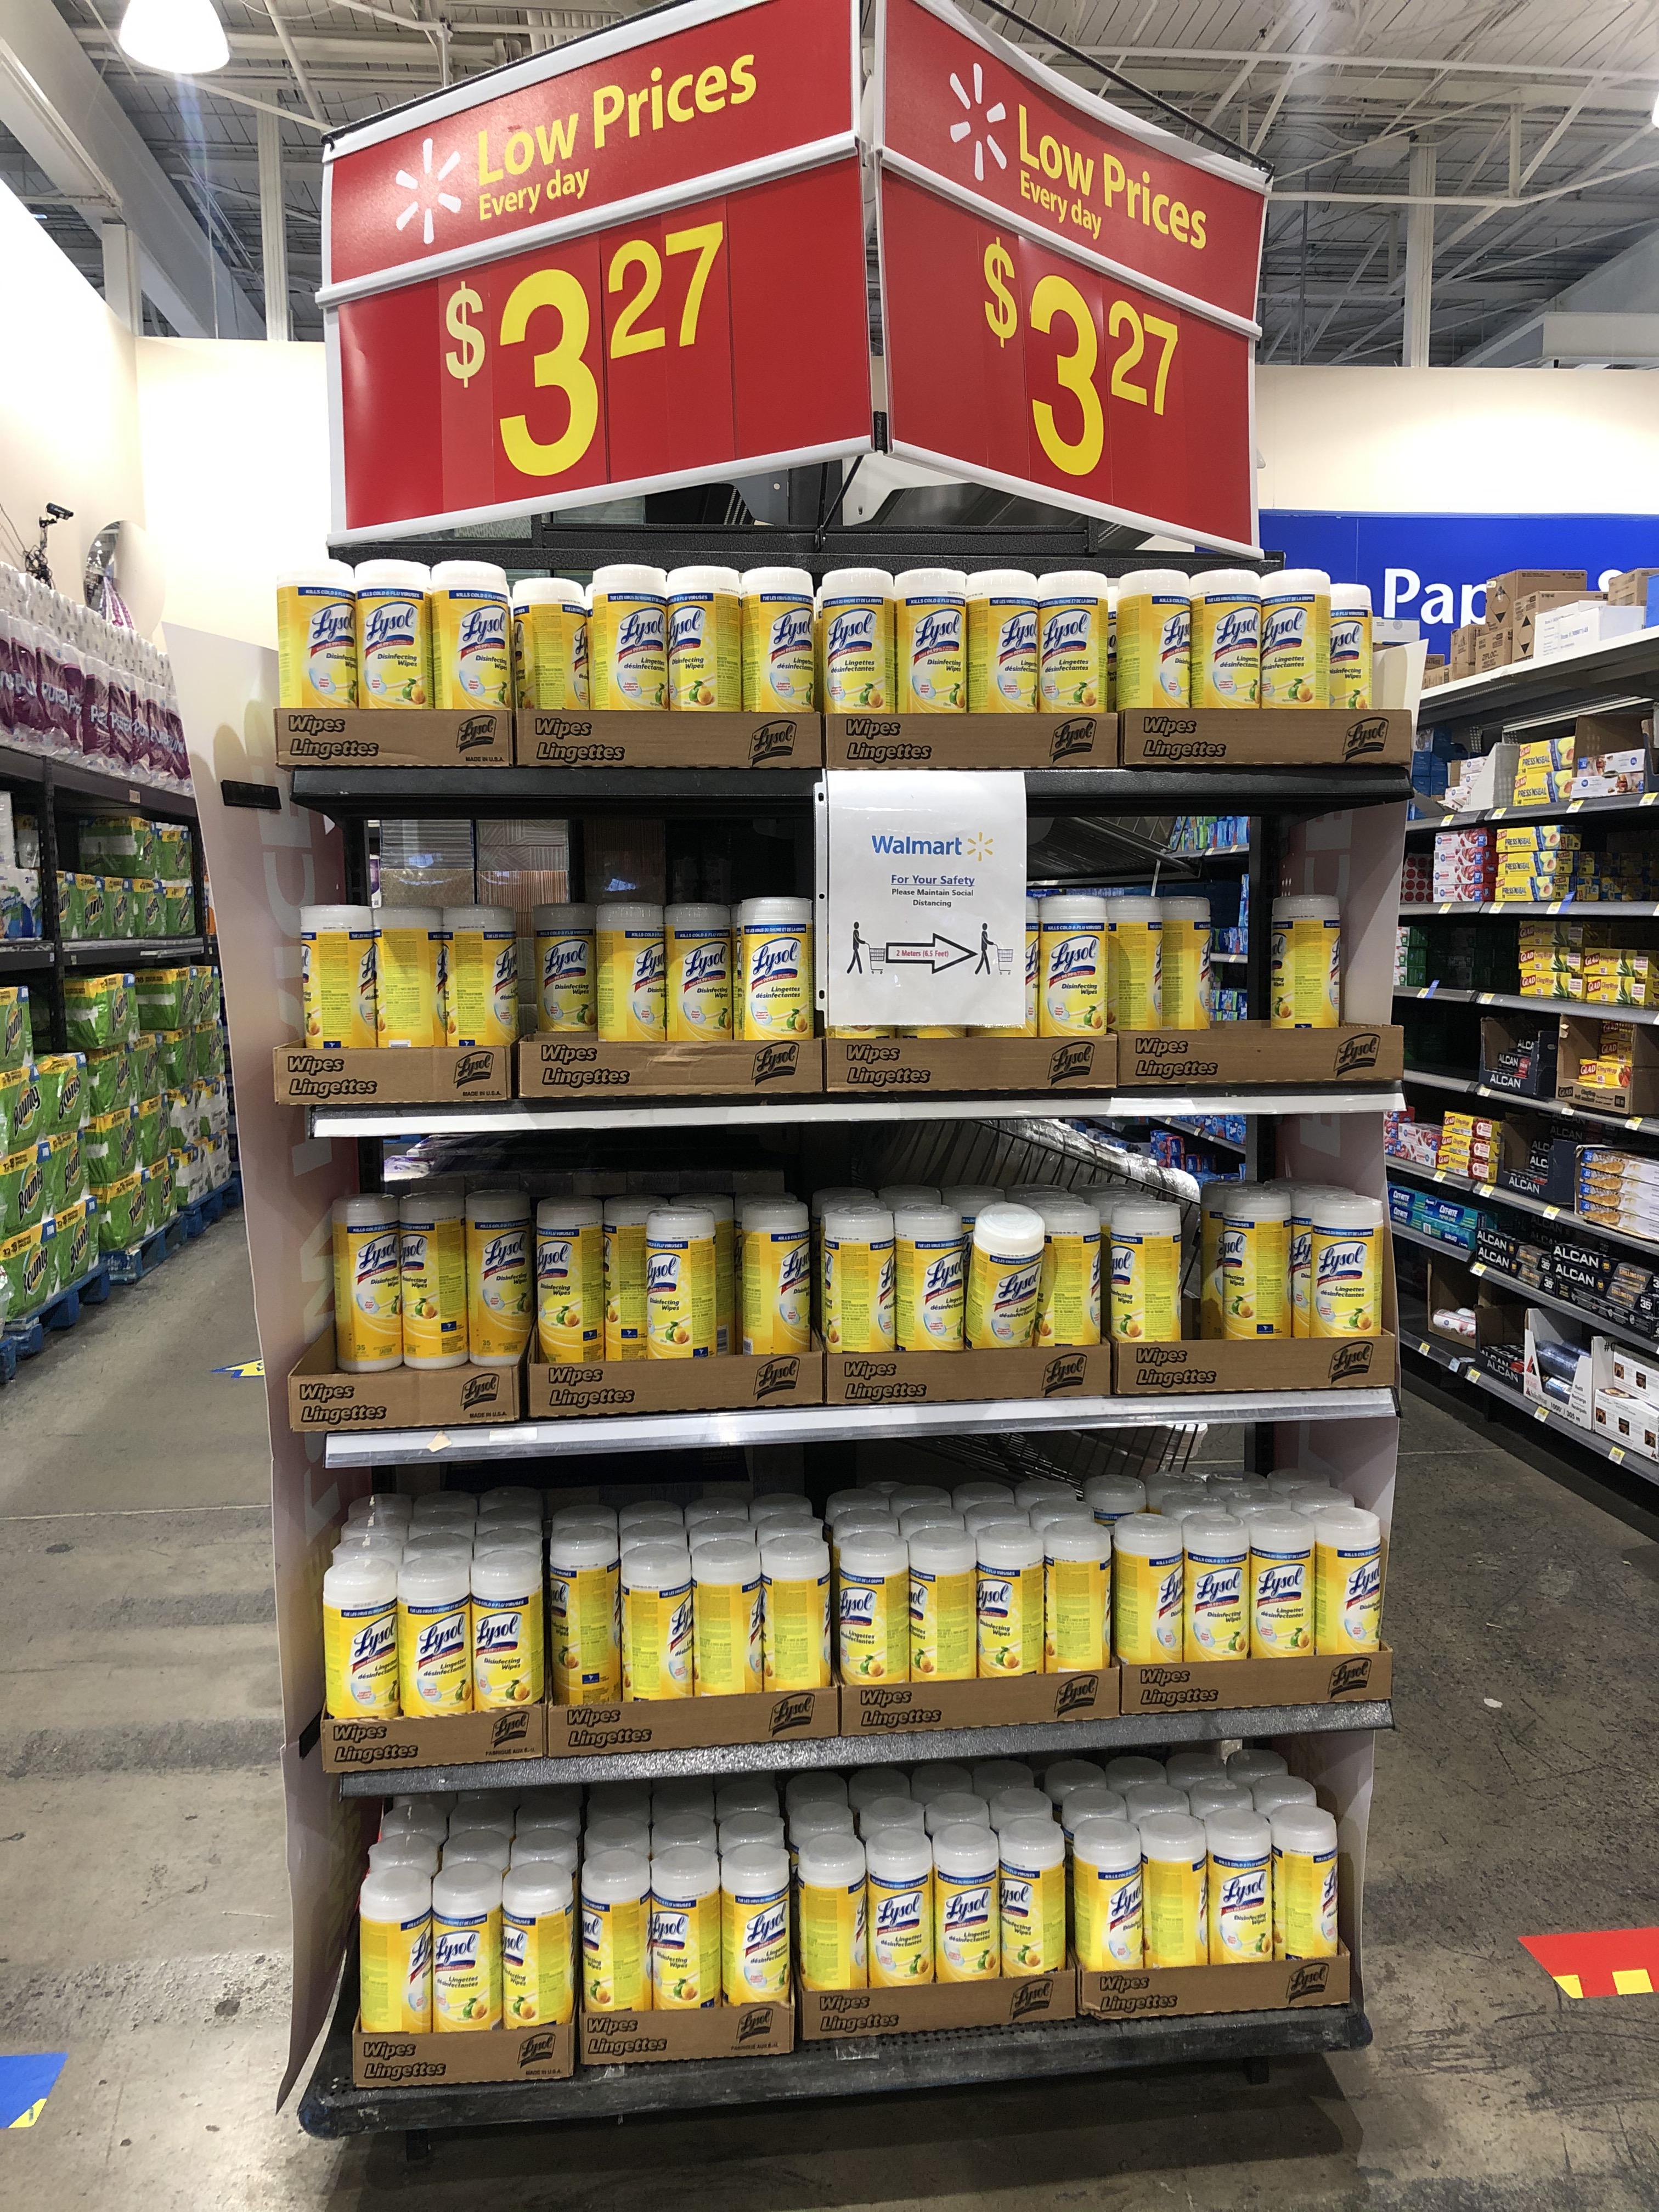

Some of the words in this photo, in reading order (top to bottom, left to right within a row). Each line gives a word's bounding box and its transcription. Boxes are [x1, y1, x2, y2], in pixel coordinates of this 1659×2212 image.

[478, 112, 580, 186] Low
[593, 54, 757, 149] Prices
[1018, 104, 1094, 195] Low
[1103, 152, 1207, 249] Prices
[479, 184, 540, 220] Every
[546, 168, 589, 200] day
[1020, 171, 1068, 224] Every
[1072, 206, 1102, 240] day
[366, 607, 414, 641] Lysol
[620, 611, 664, 645] Lysol
[828, 615, 873, 648] Lysol
[916, 614, 960, 647] Lysol
[1043, 615, 1086, 648] Lysol
[831, 665, 874, 673] désinfectantes
[844, 659, 874, 668] Lingettes
[927, 658, 961, 667] Disinfecting
[289, 715, 345, 735] Wipes
[460, 719, 494, 741] Lysol
[535, 718, 591, 739] Wipes
[847, 719, 901, 740] Wipes
[1054, 722, 1093, 749] Lysol
[1143, 716, 1197, 735] Wipes
[1347, 720, 1385, 748] Lysol
[753, 723, 793, 751] Lysol
[290, 738, 378, 759] Lingettes
[537, 742, 625, 763] Lingettes
[847, 742, 931, 763] Lingettes
[1143, 740, 1226, 760] Lingettes
[872, 835, 962, 855] Walmart
[891, 874, 909, 884] For
[912, 875, 937, 884] Your
[940, 876, 975, 887] Safety
[545, 943, 585, 974] Lysol
[752, 943, 797, 978] Lysol
[1051, 939, 1096, 972] Lysol
[1520, 951, 1534, 962] GLAD
[1585, 955, 1599, 966] GLAD
[1522, 977, 1536, 986] GLAD
[1588, 981, 1601, 992] GLAD
[541, 1045, 597, 1063] Wipes
[847, 1045, 900, 1063] Wipes
[1136, 1038, 1188, 1057] Wipes
[1339, 1037, 1376, 1065] Lysol
[287, 1056, 345, 1075] Wipes
[458, 1055, 490, 1077] Lysol
[757, 1045, 795, 1072] Lysol
[1052, 1047, 1091, 1073] Lysol
[1499, 1054, 1519, 1066] ALCAN
[543, 1068, 630, 1088] Lingettes
[847, 1068, 931, 1086] Lingettes
[1136, 1060, 1218, 1079] Lingettes
[1581, 1064, 1596, 1075] GLAD
[289, 1079, 377, 1098] Lingettes
[1490, 1074, 1521, 1088] ALCAN
[14, 1085, 41, 1139] Bounty
[18, 1166, 44, 1222] Bounty
[1509, 1176, 1540, 1194] ALCAN
[1477, 1231, 1506, 1251] ALCAN
[1318, 1248, 1363, 1275] Lysol
[1478, 1247, 1509, 1268] ALCAN
[1553, 1245, 1599, 1268] ALCAN
[998, 1265, 1040, 1299] Lysol
[1555, 1263, 1594, 1288] ALCAN
[1137, 1348, 1187, 1367] Wipes
[1333, 1346, 1369, 1372] Lysol
[549, 1368, 603, 1386] Wipes
[759, 1361, 797, 1387] Lysol
[845, 1362, 896, 1380] Wipes
[1046, 1357, 1083, 1384] Lysol
[1137, 1370, 1216, 1387] Lingettes
[1487, 1361, 1519, 1383] ALCAN
[300, 1384, 355, 1402] Wipes
[464, 1376, 496, 1398] Lysol
[845, 1384, 927, 1401] Lingettes
[549, 1390, 635, 1408] Lingettes
[301, 1406, 387, 1424] Lingettes
[1197, 1570, 1240, 1601] Lysol
[1259, 1567, 1302, 1596] Lysol
[420, 1616, 464, 1655] Lysol
[476, 1616, 518, 1647] Lysol
[1141, 1669, 1190, 1686] Wipes
[1332, 1661, 1369, 1686] Lysol
[860, 1690, 912, 1708] Wipes
[1059, 1678, 1095, 1704] Lysol
[1141, 1689, 1218, 1707] Lingettes
[567, 1708, 620, 1726] Wipes
[774, 1697, 811, 1724] Lysol
[861, 1710, 941, 1727] Lingettes
[334, 1724, 387, 1742] Wipes
[494, 1716, 527, 1738] Lysol
[568, 1729, 652, 1747] Lingettes
[335, 1745, 418, 1764] Lingettes
[1223, 1874, 1265, 1906] Lysol
[878, 1894, 921, 1927] Lysol
[946, 1890, 988, 1923] Lysol
[1100, 1976, 1149, 1993] Wipes
[1290, 1966, 1327, 1993] Lysol
[819, 1995, 870, 2012] Wipes
[1014, 1982, 1051, 2010] Lysol
[1101, 1995, 1177, 2013] Lingettes
[588, 2018, 638, 2035] Wipes
[741, 2011, 770, 2032] Lysol
[820, 2014, 899, 2030] Lingettes
[363, 2041, 416, 2059] Wipes
[521, 2036, 553, 2058] Lysol
[588, 2038, 667, 2055] Lingettes
[364, 2063, 446, 2080] Lingettes
